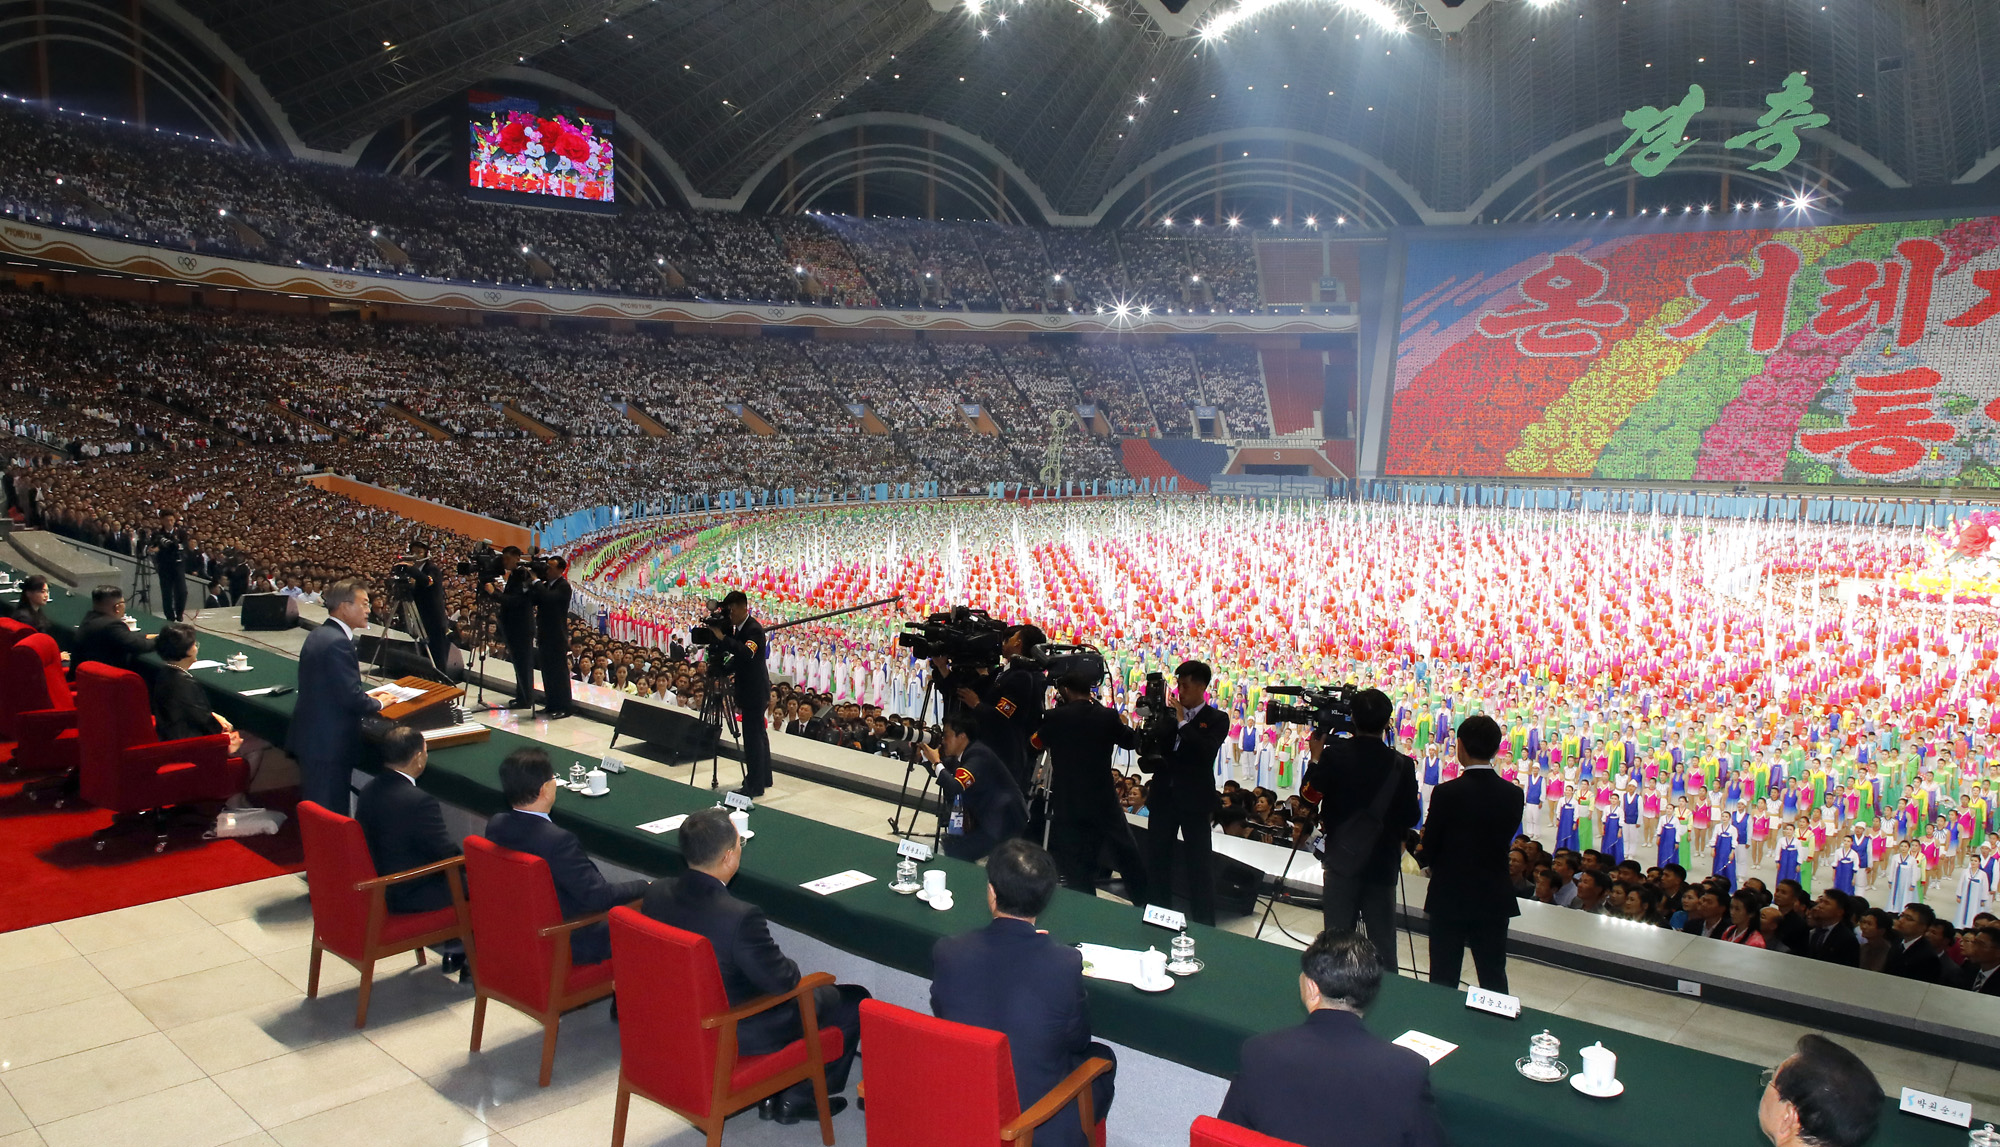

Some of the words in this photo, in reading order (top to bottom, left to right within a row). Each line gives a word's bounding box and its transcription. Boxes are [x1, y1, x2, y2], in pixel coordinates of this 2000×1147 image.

[1799, 366, 2000, 476] 통
[1273, 450, 1281, 461] 3
[1917, 1098, 1950, 1115] 박원순
